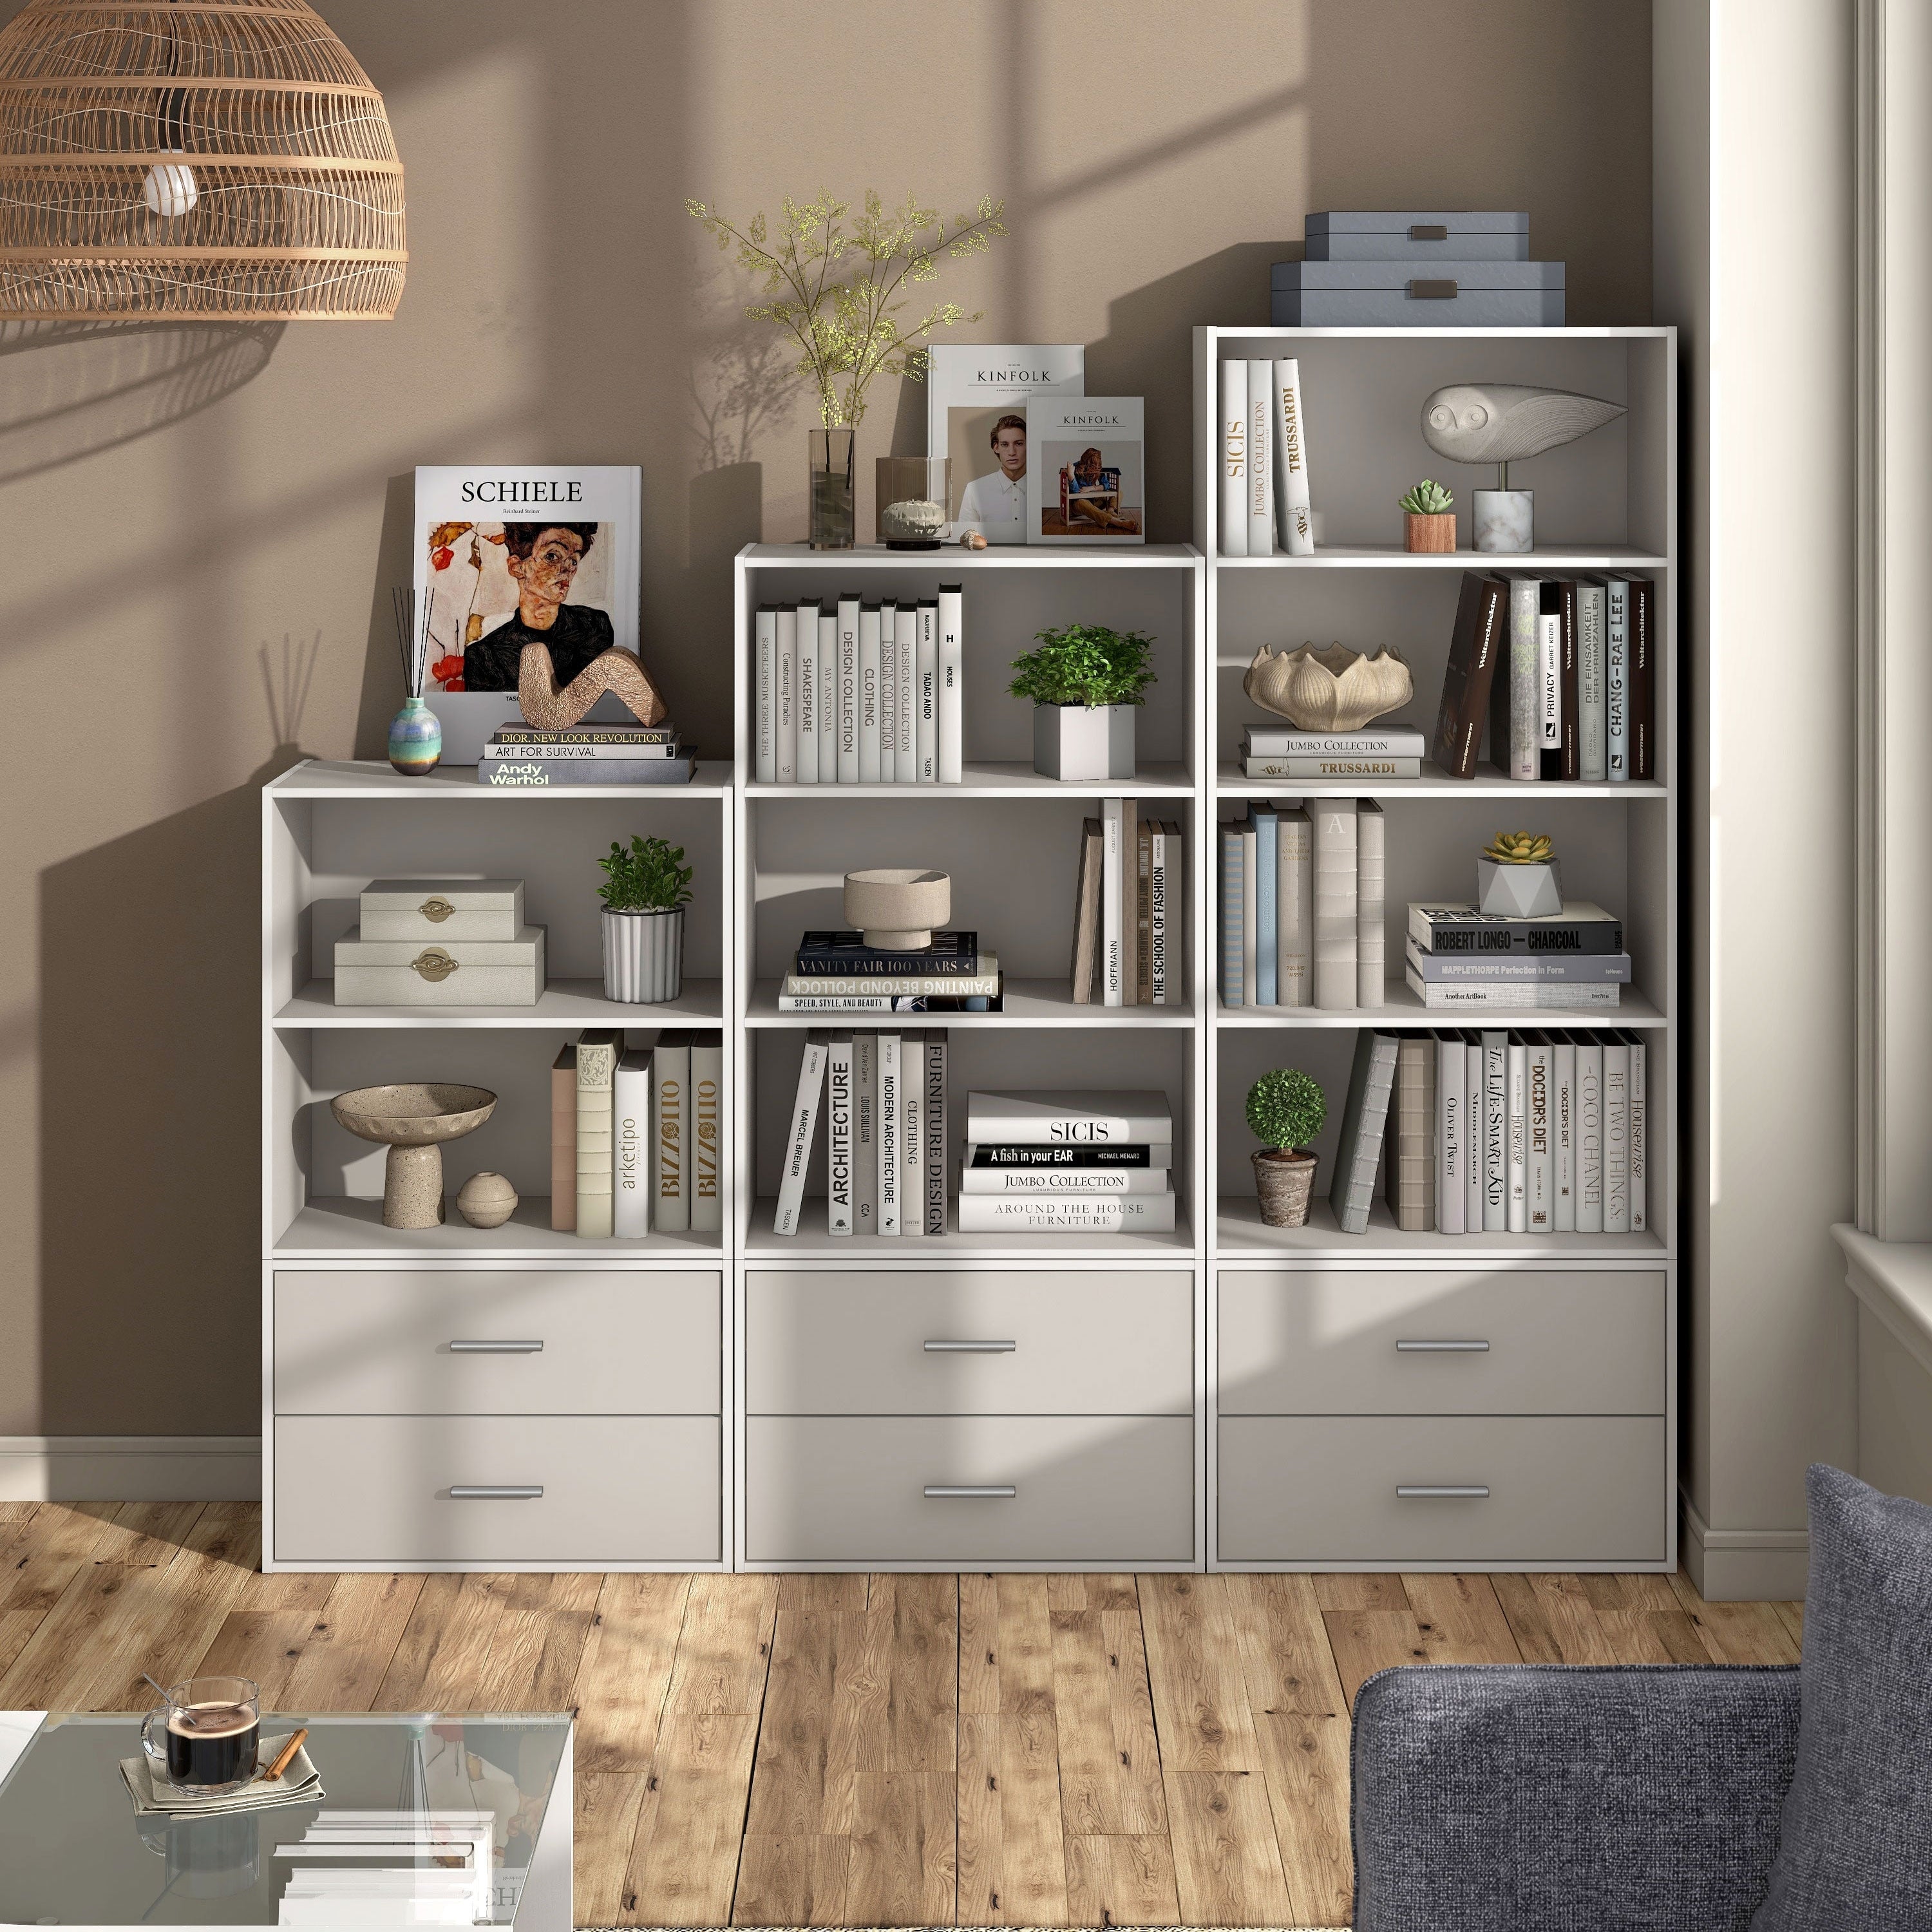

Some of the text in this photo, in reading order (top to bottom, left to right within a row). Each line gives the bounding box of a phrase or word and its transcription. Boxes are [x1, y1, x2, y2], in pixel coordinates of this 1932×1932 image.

[977, 371, 1051, 381] KINFOLK
[1283, 388, 1300, 473] TRUSSARDI
[1227, 422, 1244, 477] SICIS
[1253, 402, 1267, 516] JUMBO COLLECTION
[462, 481, 582, 502] SCHIELE
[1611, 594, 1622, 625] LEE
[1479, 592, 1497, 669] Weltarchitektur
[781, 652, 790, 696] Constructing
[825, 667, 831, 682] MY
[803, 658, 811, 732] SHAKESPEARE
[844, 632, 853, 752] DESIGN COLLECTION
[865, 668, 874, 726] CLOTHING
[882, 641, 893, 750] DESIGN COLLECTION
[502, 734, 662, 743] DIOR. NEW LOOK REVOLUTION
[1286, 741, 1388, 752] JUMBO COLLECTION
[495, 747, 596, 757] ART FOR SURVIVAL
[489, 775, 549, 785] Warhol
[497, 764, 542, 777] Andy
[1320, 763, 1396, 773] TRUSSARDI
[1326, 814, 1346, 834] A
[1139, 838, 1148, 876] J.K. ROWLING
[1139, 878, 1148, 897] HARRY
[1139, 898, 1148, 918] POTTER
[1154, 867, 1164, 998] THE SCHOOL OF FASHION
[1435, 931, 1581, 950] ROBERT LONGO CHARCOAL
[800, 961, 957, 972] VANITY FAIR YEARS
[1139, 961, 1148, 985] SECRETS
[1442, 965, 1564, 974] MAPPLETHORPE Perfection in Form
[791, 980, 992, 994] PAINTING BEYOND POLLOCK
[795, 999, 883, 1008] SPEED, STYLE, AND BEAUTY
[1489, 1046, 1502, 1072] The
[1609, 1072, 1623, 1091] BE
[861, 1096, 869, 1142] LOUIS SULLIVAN
[1051, 1122, 1108, 1141] SICIS
[1609, 1097, 1624, 1141] TWO
[791, 1109, 809, 1177] MARCEL BREUER
[833, 1062, 848, 1206] ARCHITECTURE
[884, 1076, 894, 1204] MODERN ARCHITECTURE
[907, 1101, 917, 1165] CLOTHING
[930, 1046, 942, 1234] FURNITURE DESIGN
[1447, 1097, 1457, 1177] OLIVER TWIST
[1511, 1115, 1524, 1165] Housewise
[1533, 1128, 1546, 1154] DIET
[1632, 1100, 1643, 1178] Housewise
[619, 1119, 640, 1189] arketipo
[990, 1148, 1073, 1164] A fish in your EAR
[1005, 1175, 1124, 1189] JUMBO COLLECTION
[1584, 1135, 1599, 1209] CHANEL
[995, 1204, 1144, 1213] AROUND THE HOUSE
[1028, 1216, 1110, 1224] FURNITURE
